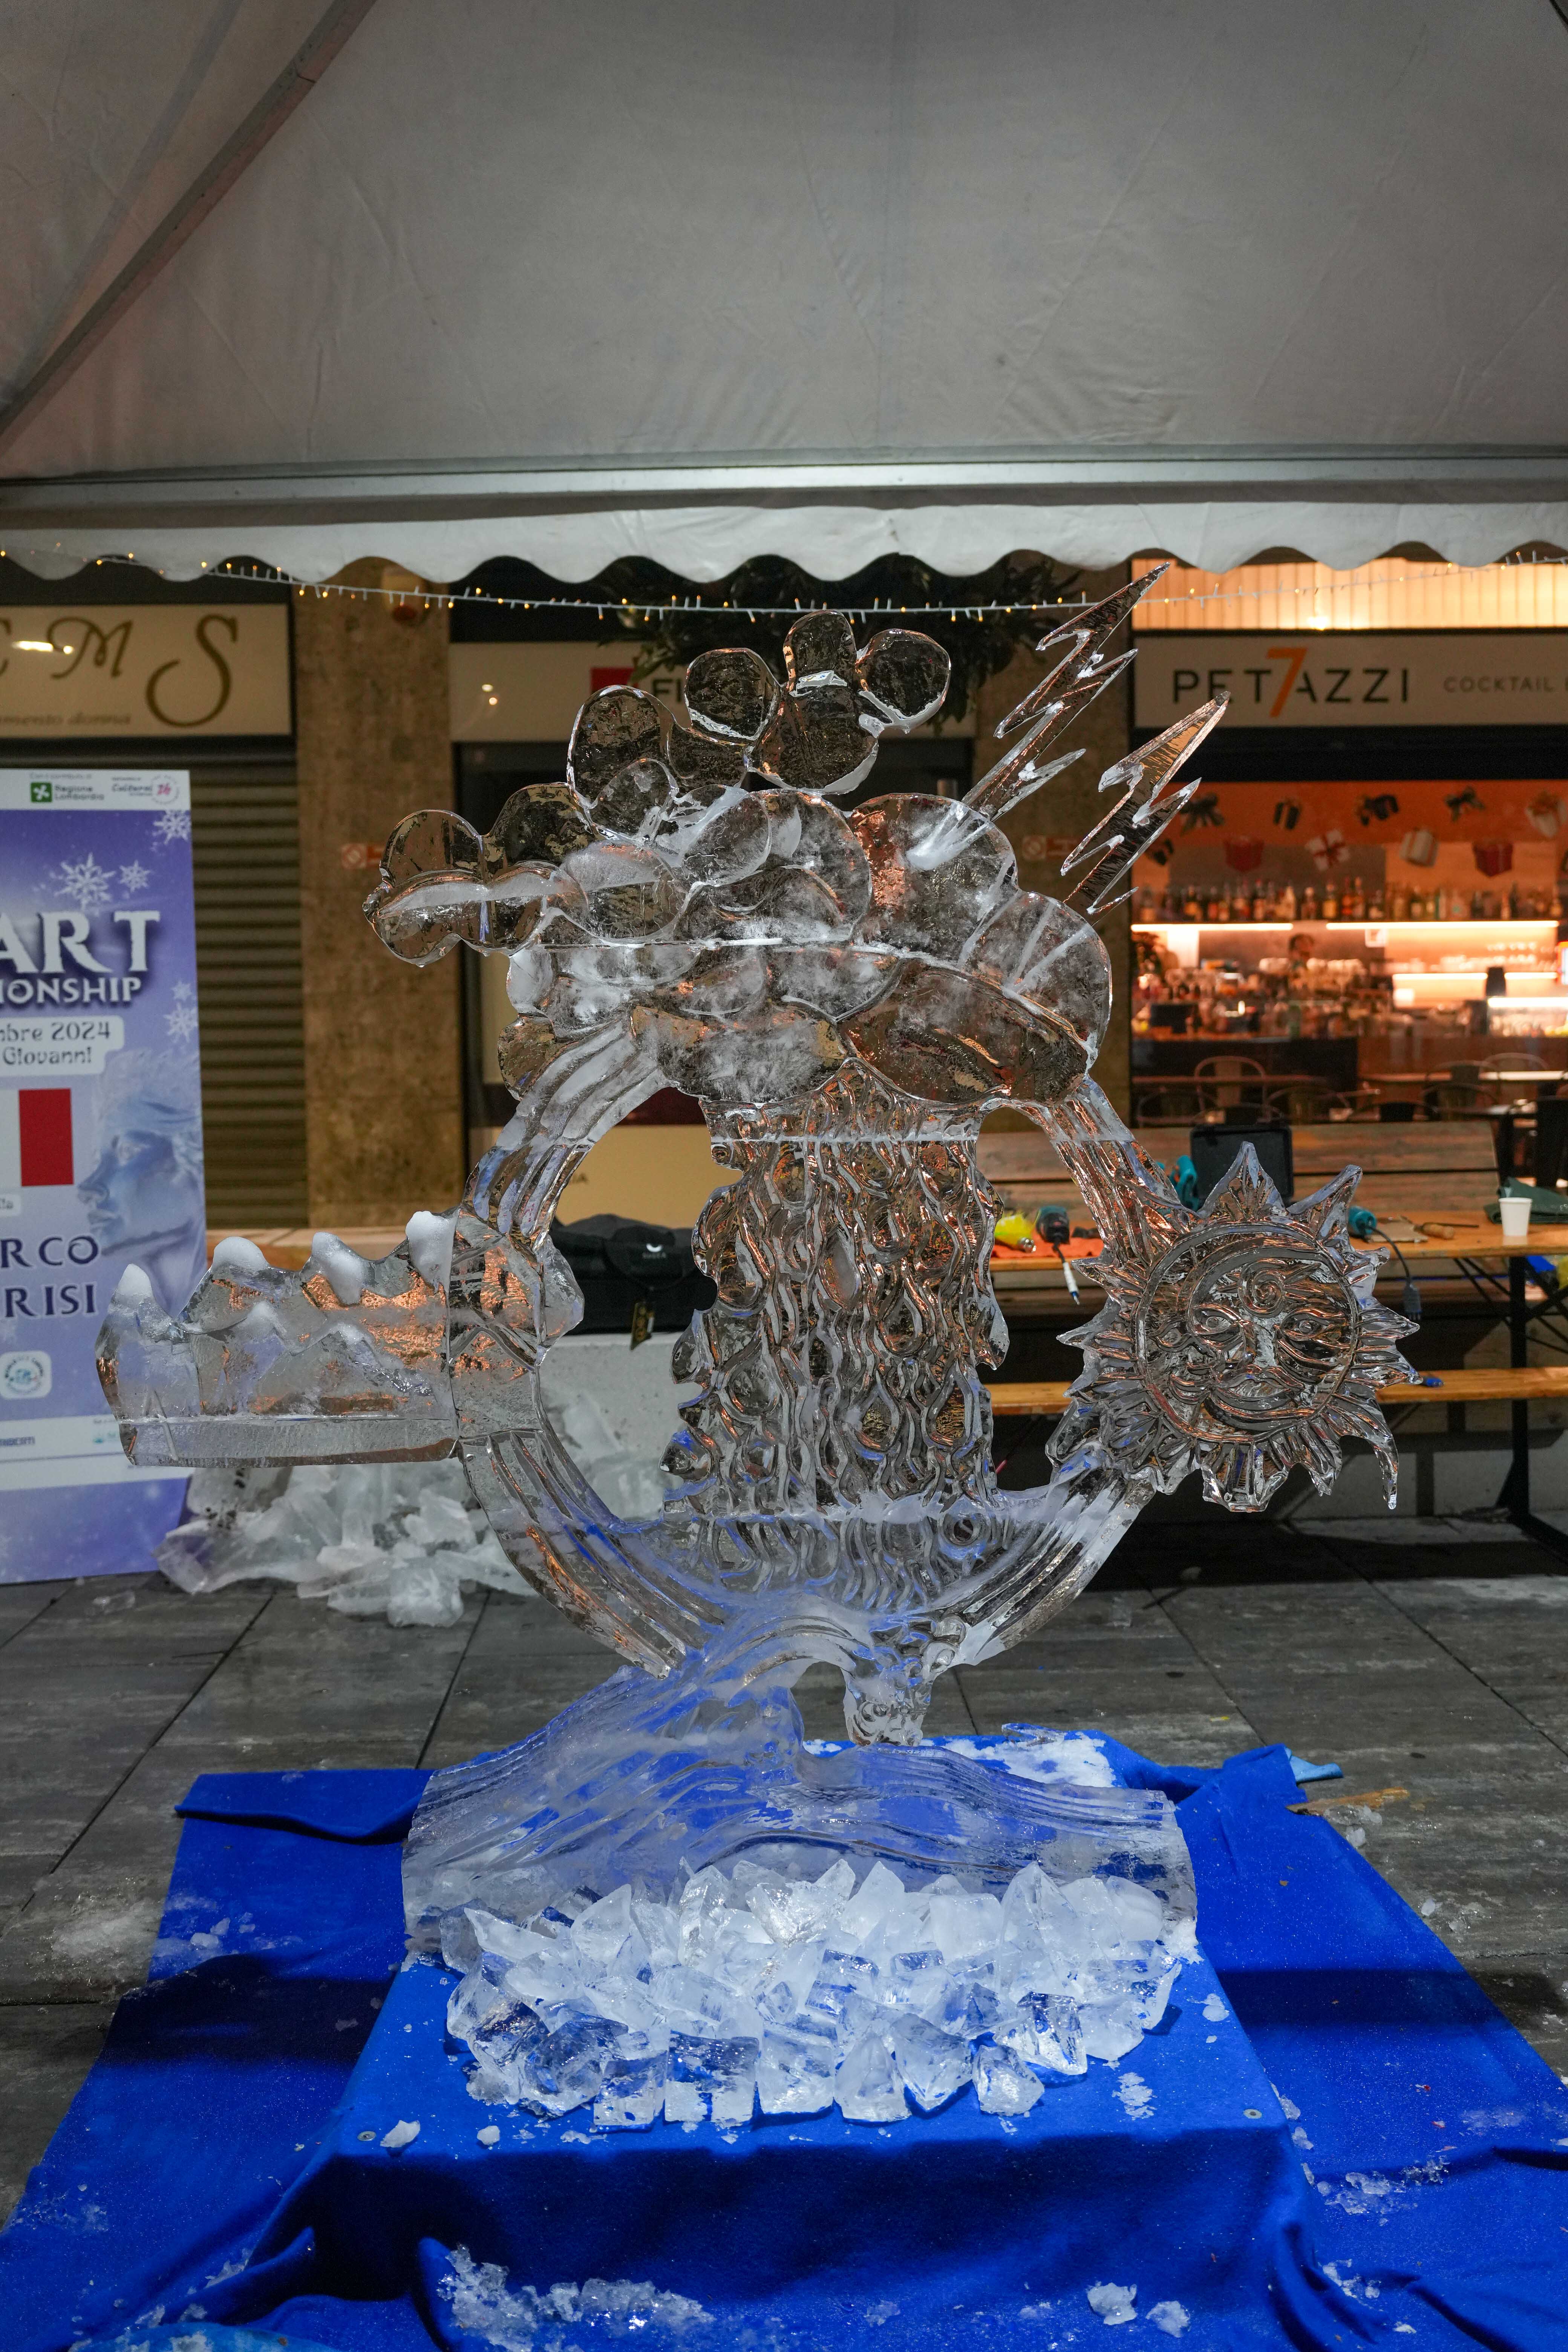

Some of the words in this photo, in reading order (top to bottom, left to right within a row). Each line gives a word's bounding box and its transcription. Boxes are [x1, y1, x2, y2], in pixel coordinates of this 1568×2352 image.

[1443, 676, 1554, 694] COCKTAIL
[51, 1021, 111, 1041] 2024
[3, 1046, 92, 1066] Giovanni
[0, 1235, 98, 1268] RCO
[5, 1284, 96, 1318] RISI
